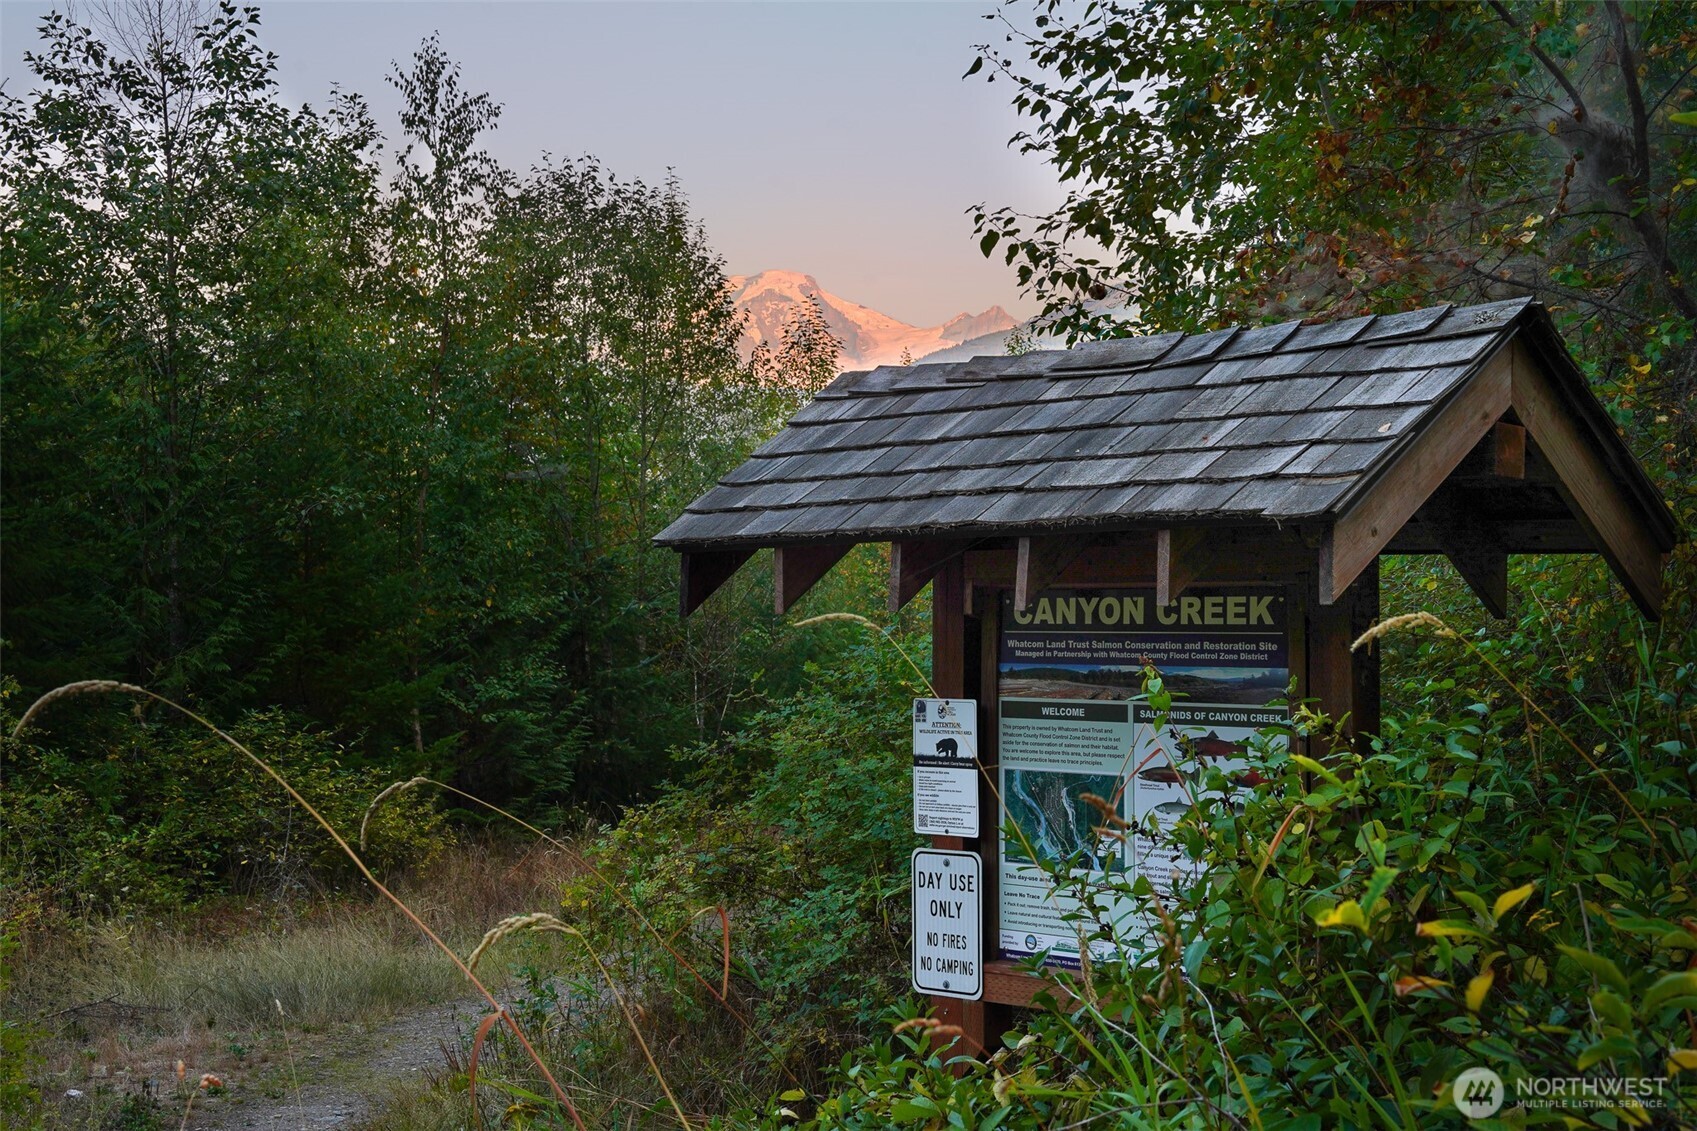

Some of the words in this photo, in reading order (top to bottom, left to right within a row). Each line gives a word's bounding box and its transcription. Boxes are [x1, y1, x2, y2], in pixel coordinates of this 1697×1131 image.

[1014, 596, 1144, 625] CANYON
[1156, 596, 1274, 625] CREEK
[1007, 640, 1044, 648] Whatcom
[1046, 640, 1066, 648] Land
[1068, 640, 1090, 648] Trust
[1092, 640, 1122, 649] Salmon
[1124, 641, 1182, 650] Conservation
[1184, 642, 1200, 650] and
[1203, 642, 1256, 650] Restoration
[1258, 642, 1278, 650] Site
[1015, 650, 1044, 658] Managed
[1053, 651, 1092, 659] Partnership
[1143, 652, 1168, 660] County
[1041, 706, 1085, 717] WELCOME
[1194, 712, 1206, 720] OF
[1208, 712, 1247, 722] CANYON
[1250, 714, 1282, 722] CREEK
[918, 871, 943, 890] DAY
[950, 874, 974, 892] USE
[930, 900, 963, 919] ONLY
[927, 932, 939, 947] NO
[942, 933, 967, 950] FIRES
[920, 956, 932, 971] NO
[936, 957, 974, 976] CAMPING
